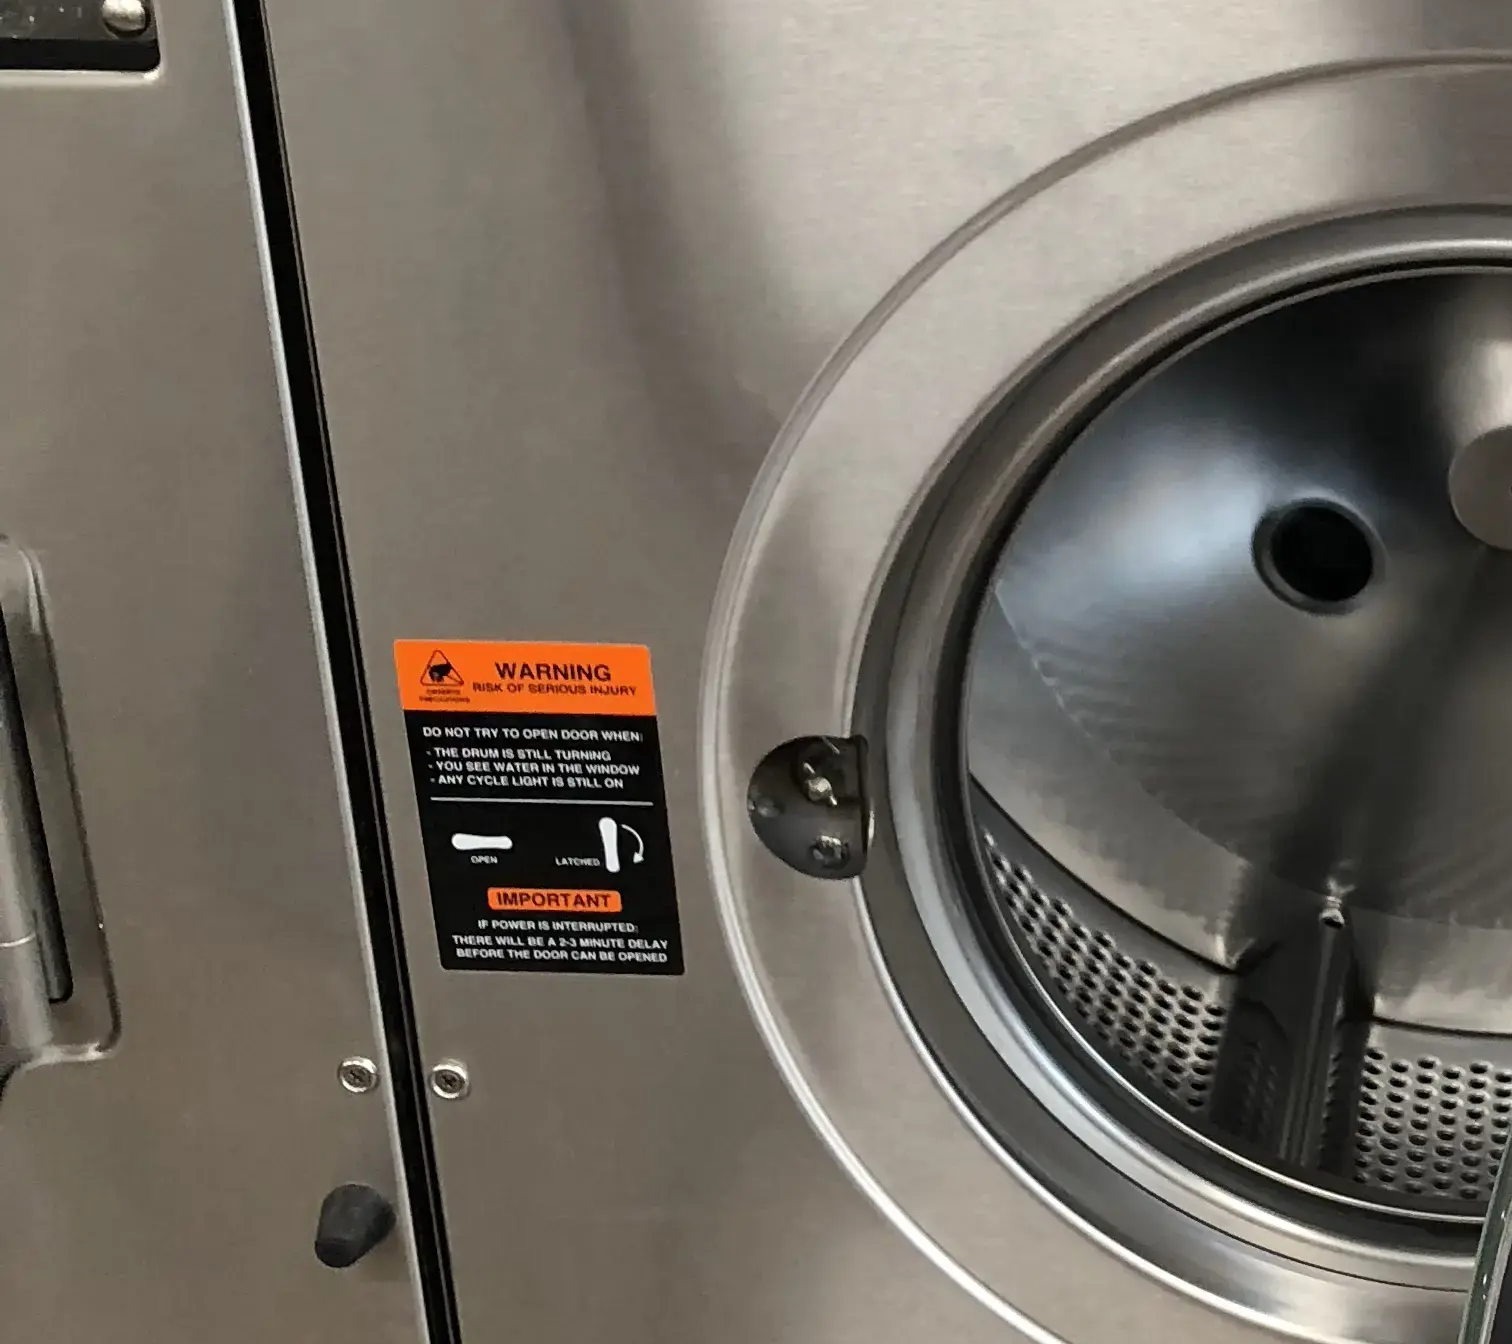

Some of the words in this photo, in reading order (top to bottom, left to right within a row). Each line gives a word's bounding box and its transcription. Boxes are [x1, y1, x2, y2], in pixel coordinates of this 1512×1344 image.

[495, 662, 612, 681] WARNING
[423, 726, 442, 737] DO
[445, 727, 470, 737] NOT
[474, 728, 499, 738] TRY
[502, 728, 519, 739] TO
[523, 729, 558, 740] OPEN
[561, 729, 599, 740] DOOR
[471, 856, 497, 864] OPEN
[555, 857, 600, 866] LATCHED
[496, 891, 611, 907] IMPORTANT
